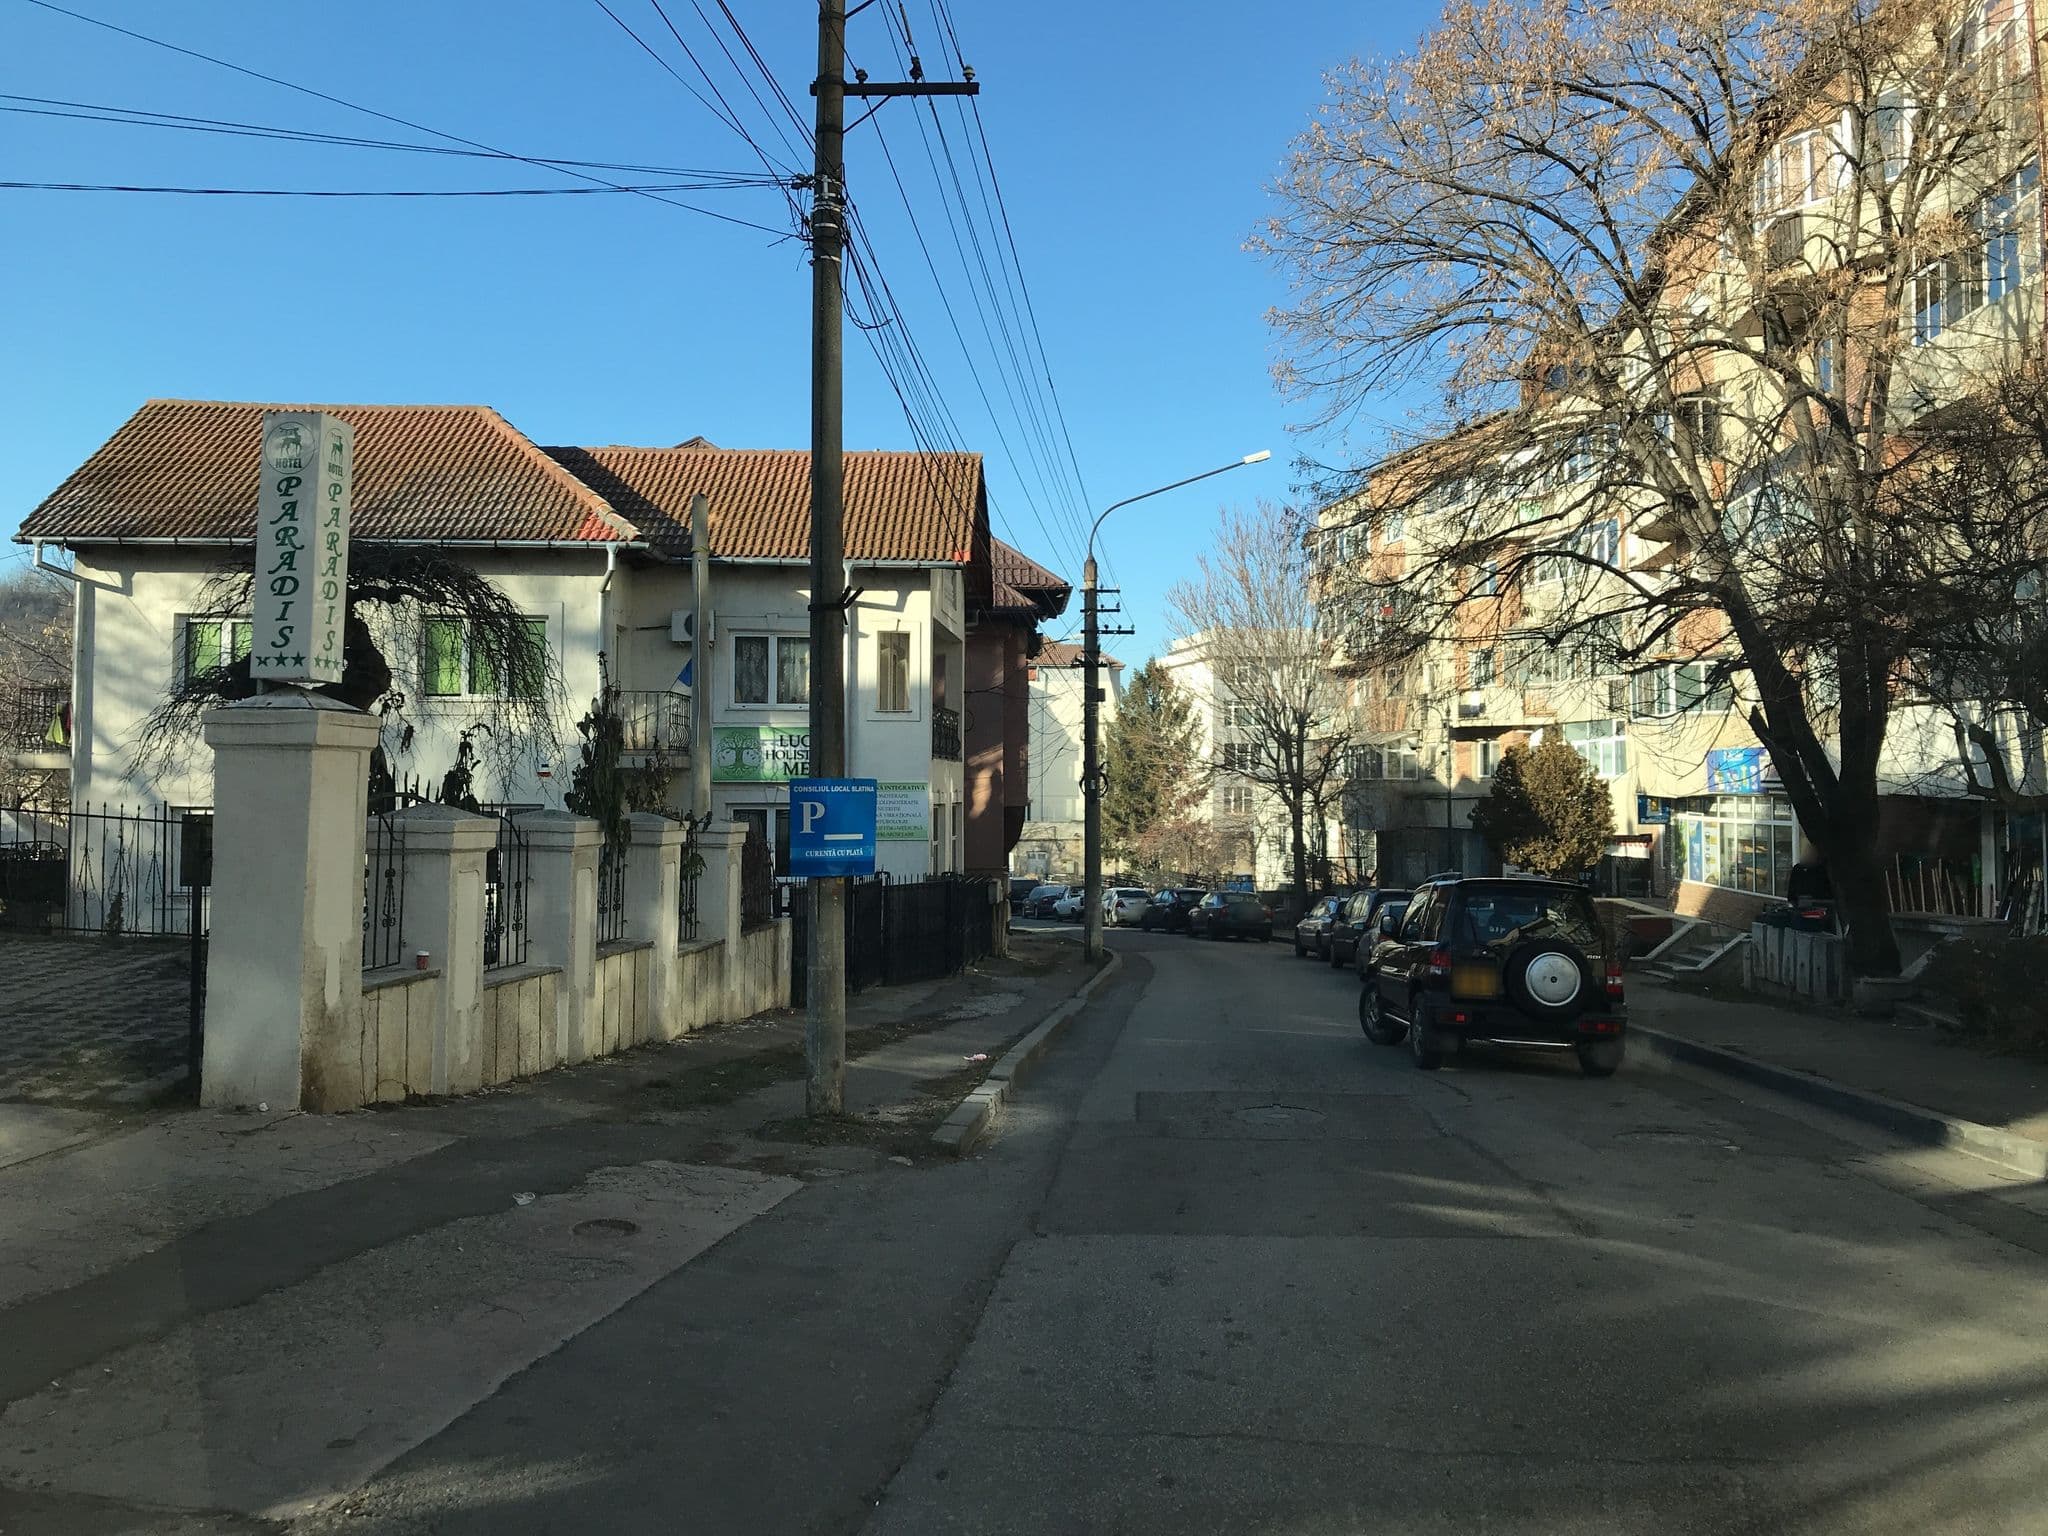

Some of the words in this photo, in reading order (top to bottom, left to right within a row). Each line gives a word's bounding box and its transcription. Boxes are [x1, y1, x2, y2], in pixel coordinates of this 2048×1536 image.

[276, 458, 302, 469] HOTEL
[328, 461, 343, 478] HOTEL
[268, 476, 305, 649] PARADIS
[321, 482, 343, 651] PARADIS
[799, 801, 826, 834] P
[805, 848, 836, 857] CURENTĂ
[836, 849, 846, 857] CU
[846, 847, 864, 856] PLATĂ
